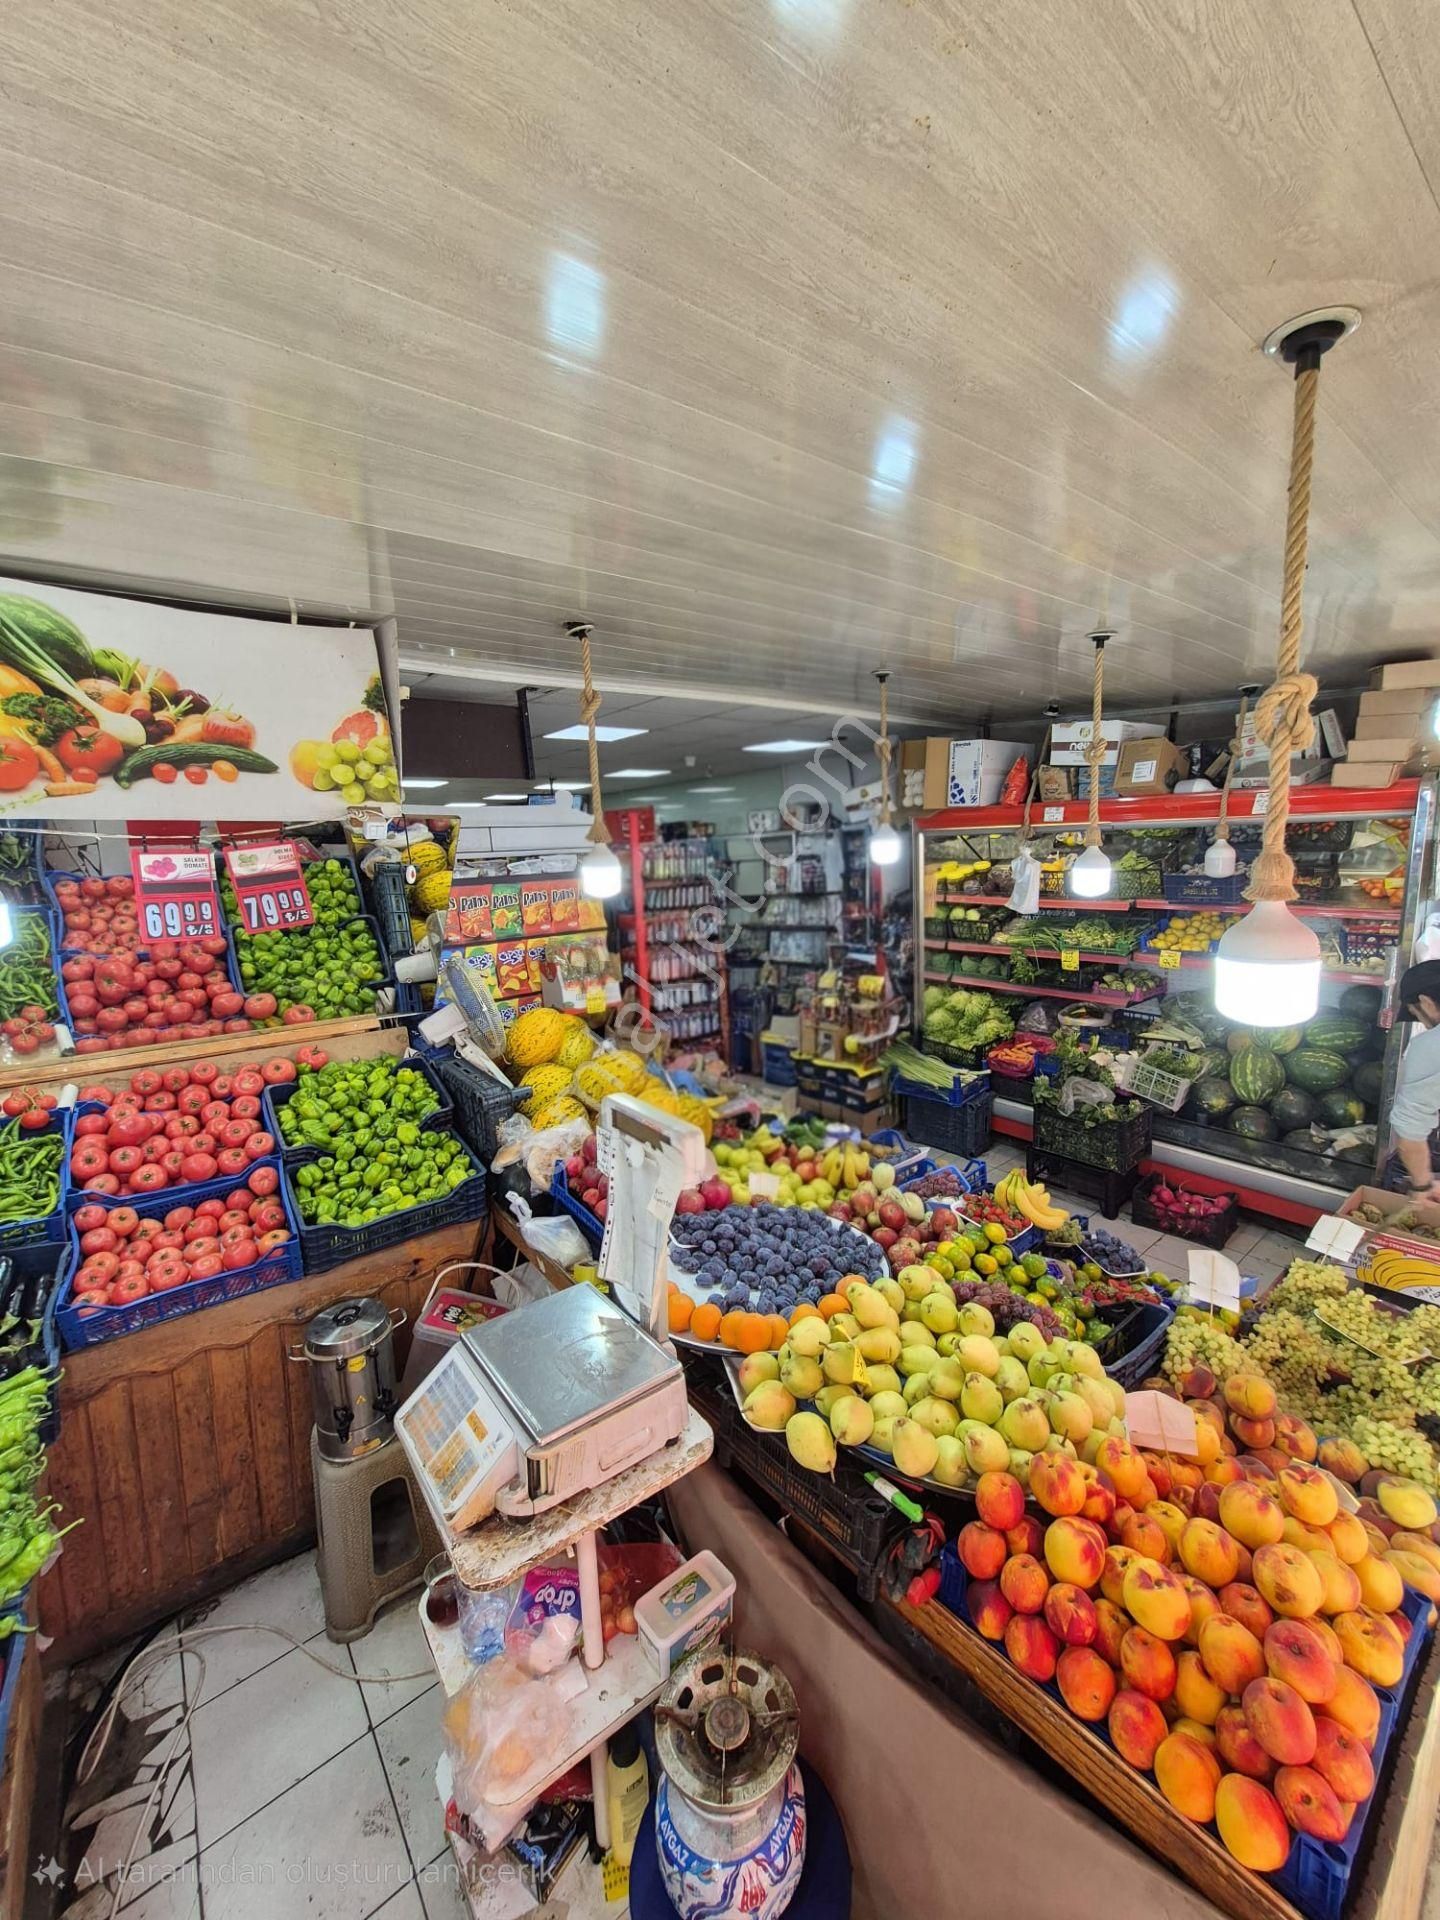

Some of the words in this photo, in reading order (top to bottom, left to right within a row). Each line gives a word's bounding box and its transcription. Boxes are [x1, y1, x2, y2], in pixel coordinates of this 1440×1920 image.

[534, 1584, 576, 1612] drop
[661, 1820, 690, 1868] AYGAZ
[770, 1804, 794, 1859] AYGAZ
